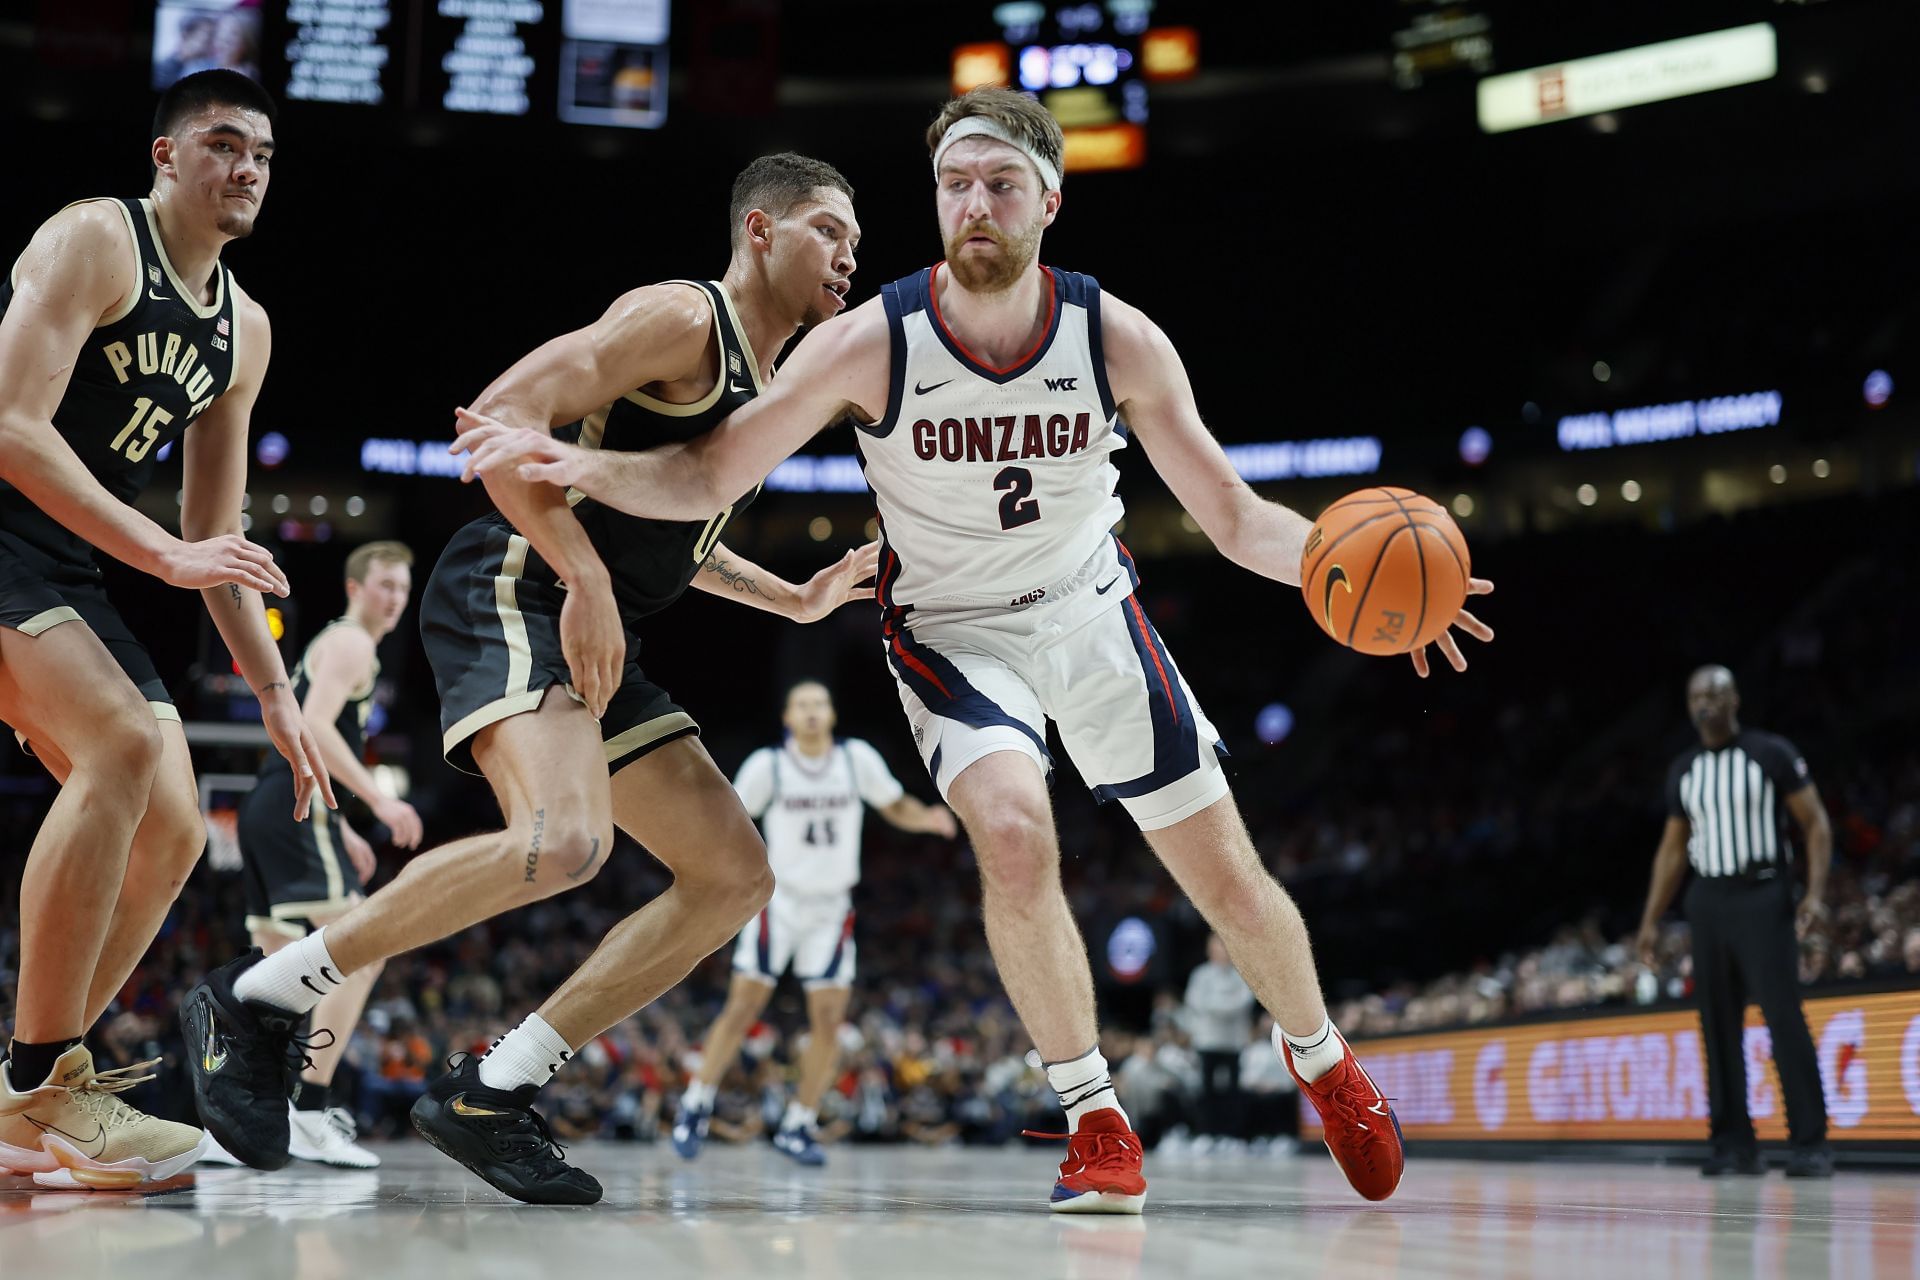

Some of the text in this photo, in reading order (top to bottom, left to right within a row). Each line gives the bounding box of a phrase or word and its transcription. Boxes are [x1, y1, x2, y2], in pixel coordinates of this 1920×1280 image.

[109, 397, 175, 463] 15
[912, 412, 1091, 463] GONZAGA
[993, 465, 1041, 531] 2
[804, 820, 836, 846] 45
[1527, 1025, 1776, 1122] GATORAE
